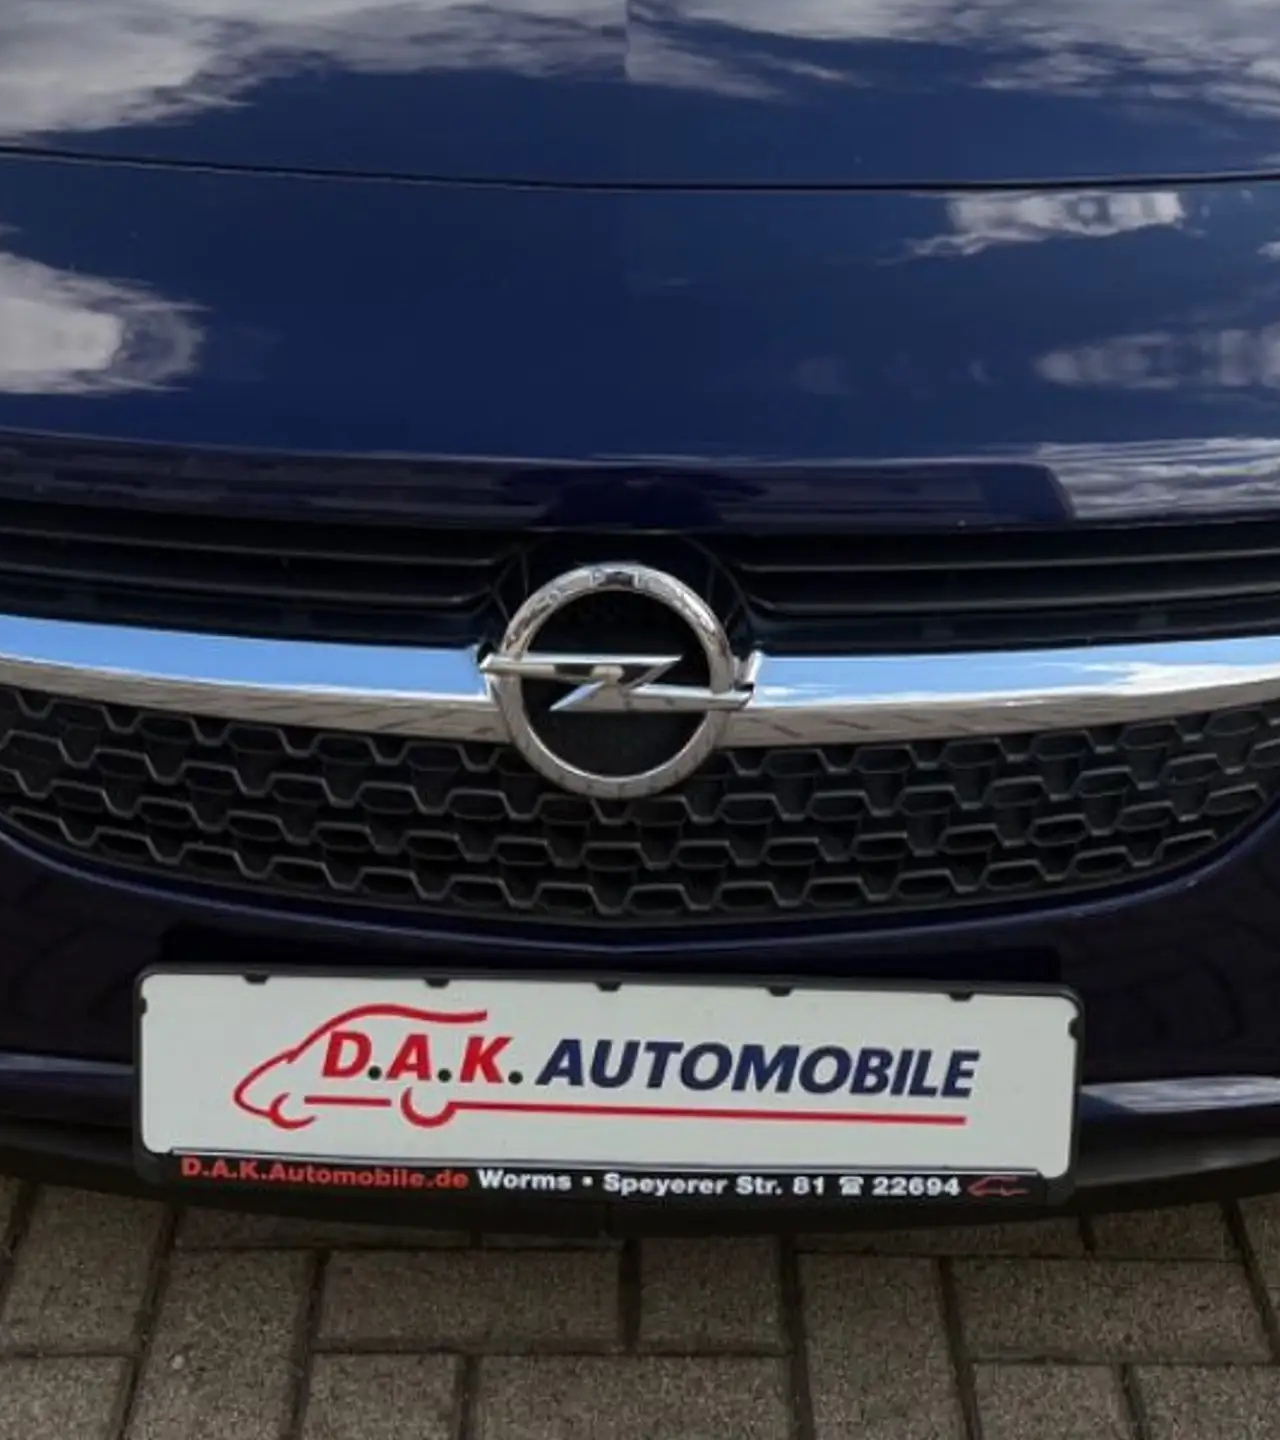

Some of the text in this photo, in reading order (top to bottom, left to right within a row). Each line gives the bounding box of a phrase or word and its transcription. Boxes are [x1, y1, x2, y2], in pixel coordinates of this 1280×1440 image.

[321, 1030, 981, 1099] D.A.K. AUTOMOBILE
[180, 1156, 962, 1198] D.A.K.Automobile.de Worms Speyerer Str. 81 22694
